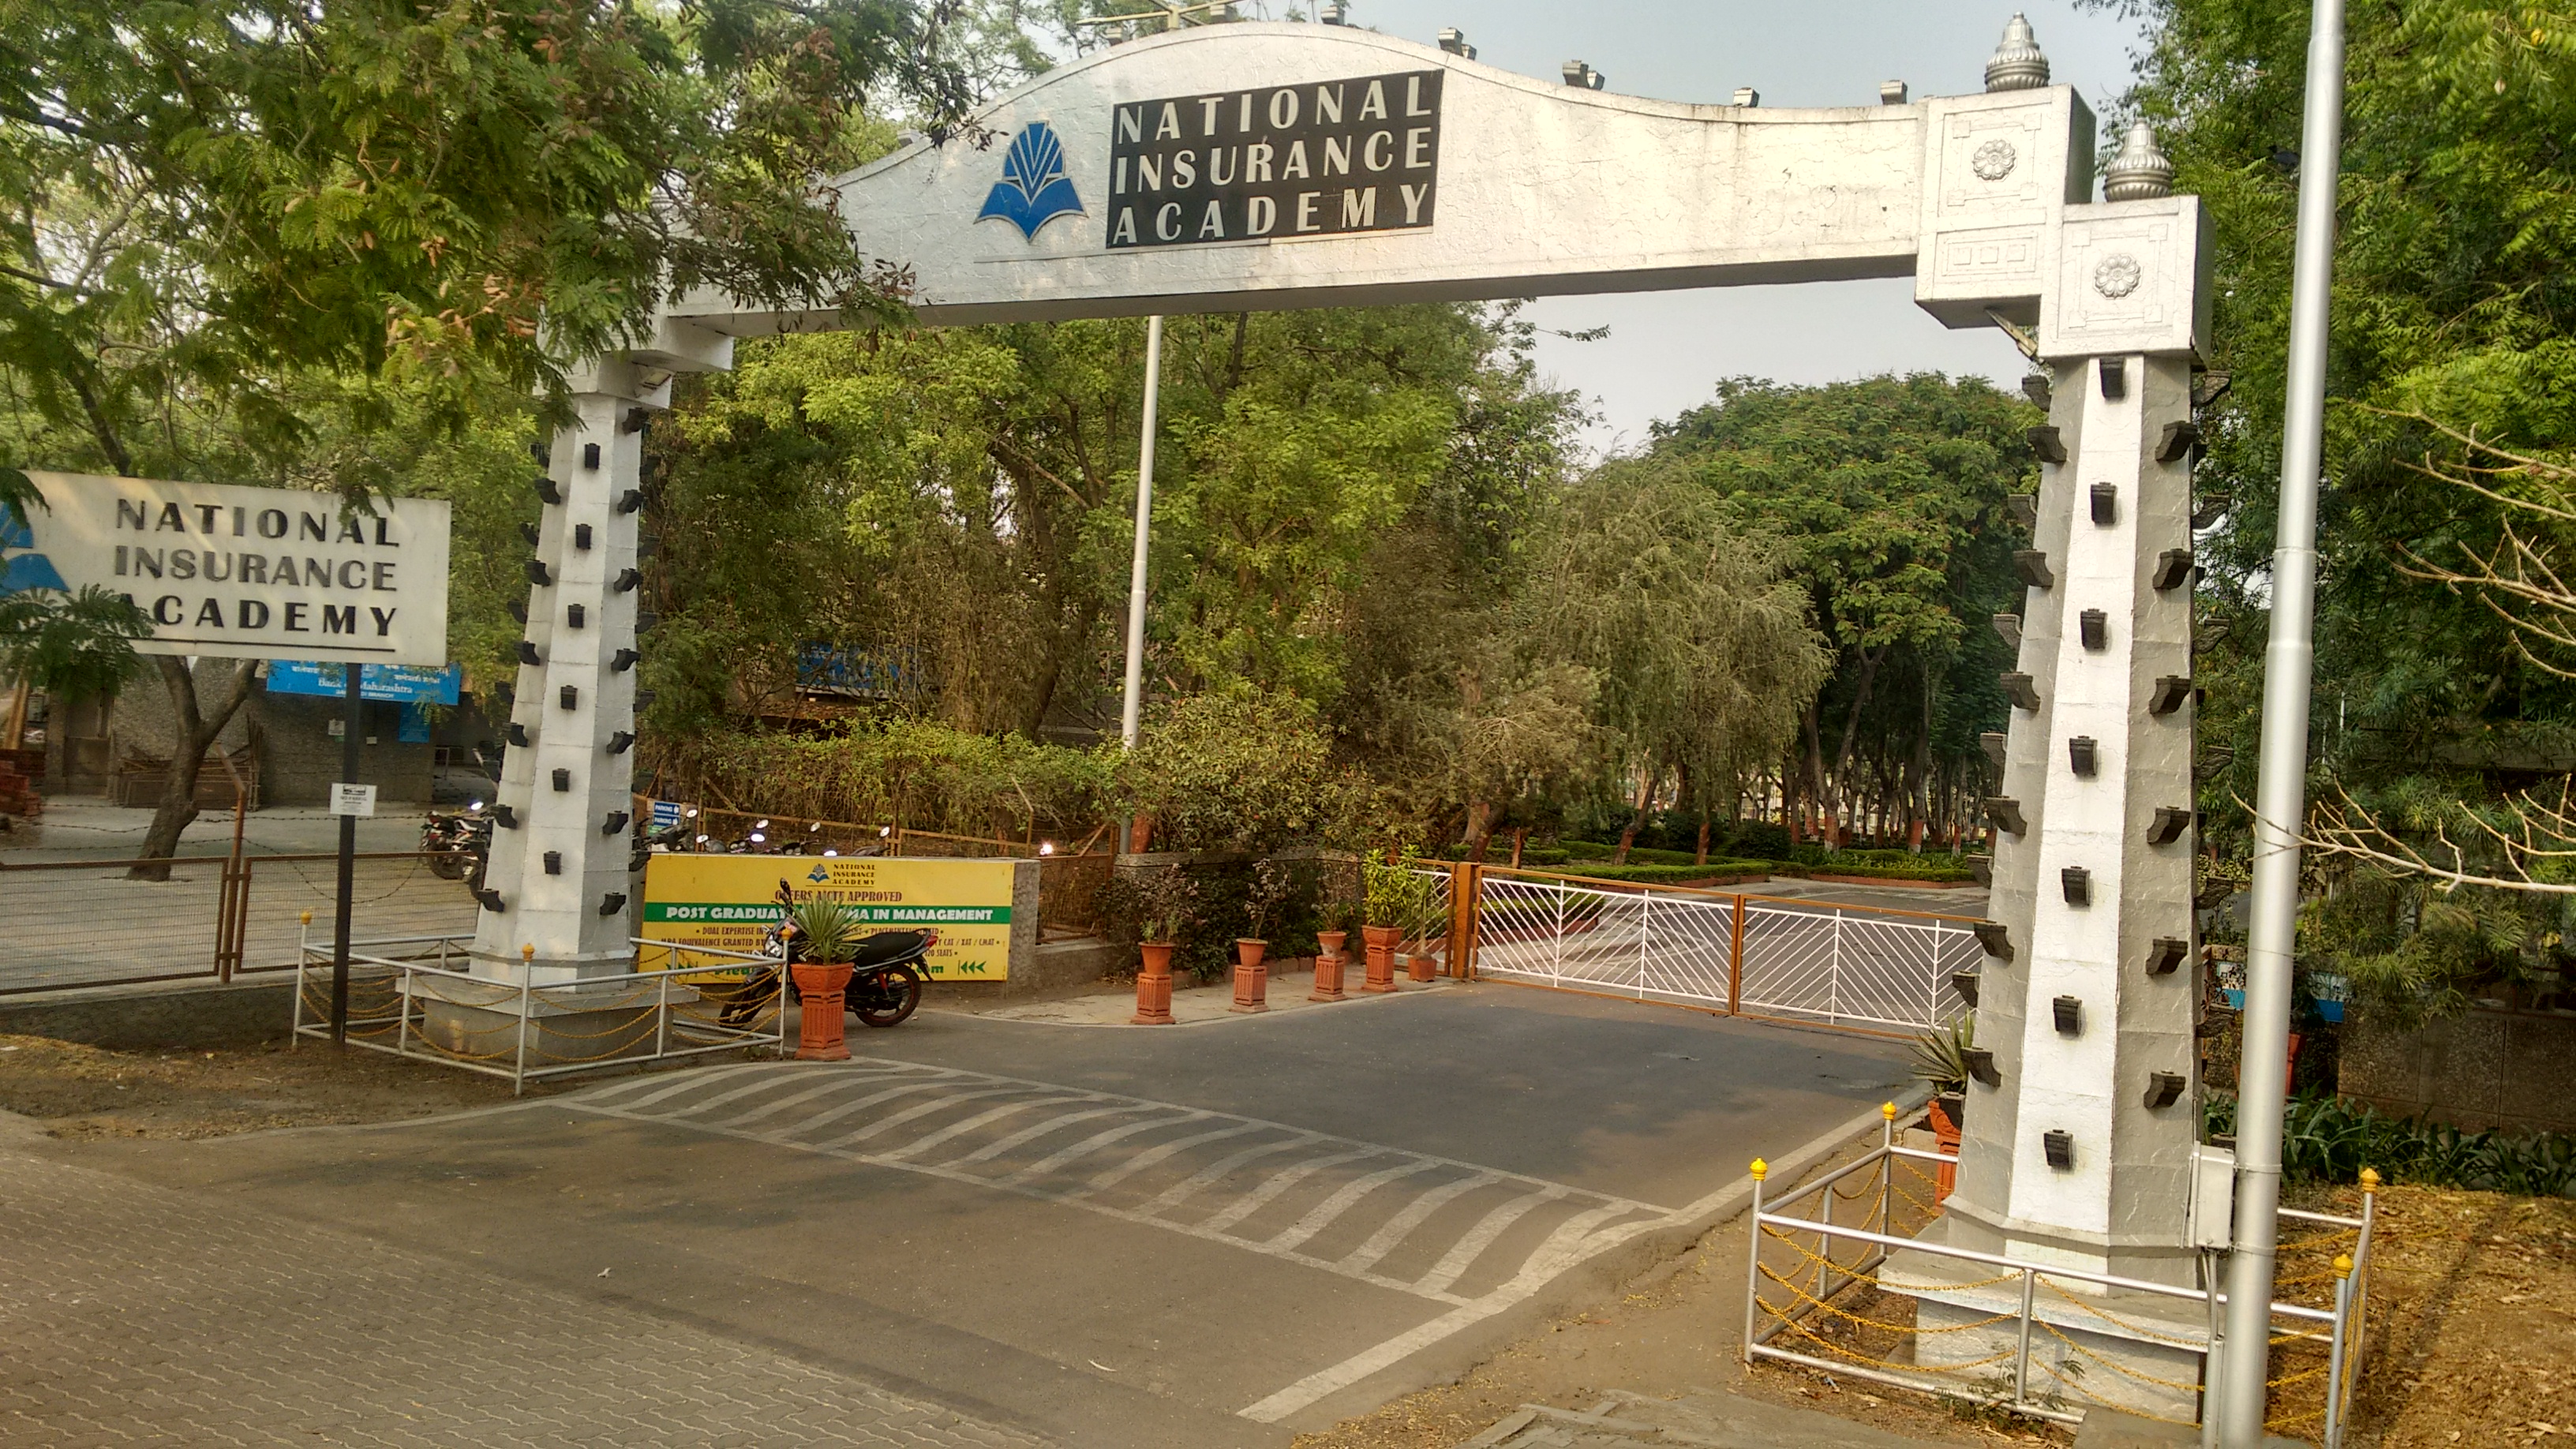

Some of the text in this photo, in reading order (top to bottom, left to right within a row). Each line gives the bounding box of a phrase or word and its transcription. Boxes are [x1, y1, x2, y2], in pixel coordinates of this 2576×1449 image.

[1118, 76, 1432, 144] NATIONAL
[1115, 126, 1432, 194] INSURANCE
[1113, 183, 1428, 244] ACADEMY
[116, 498, 399, 548] NATIONAL
[114, 545, 398, 592] INSURANCE
[666, 907, 708, 919] POST
[710, 908, 786, 919] GRADUAT
[873, 908, 890, 920] IN
[892, 908, 994, 921] MANAGEMENT
[775, 889, 813, 901] OFERS
[847, 891, 903, 902] APPROVED
[702, 927, 720, 936] DUAL
[721, 927, 755, 936] EXPERTISE
